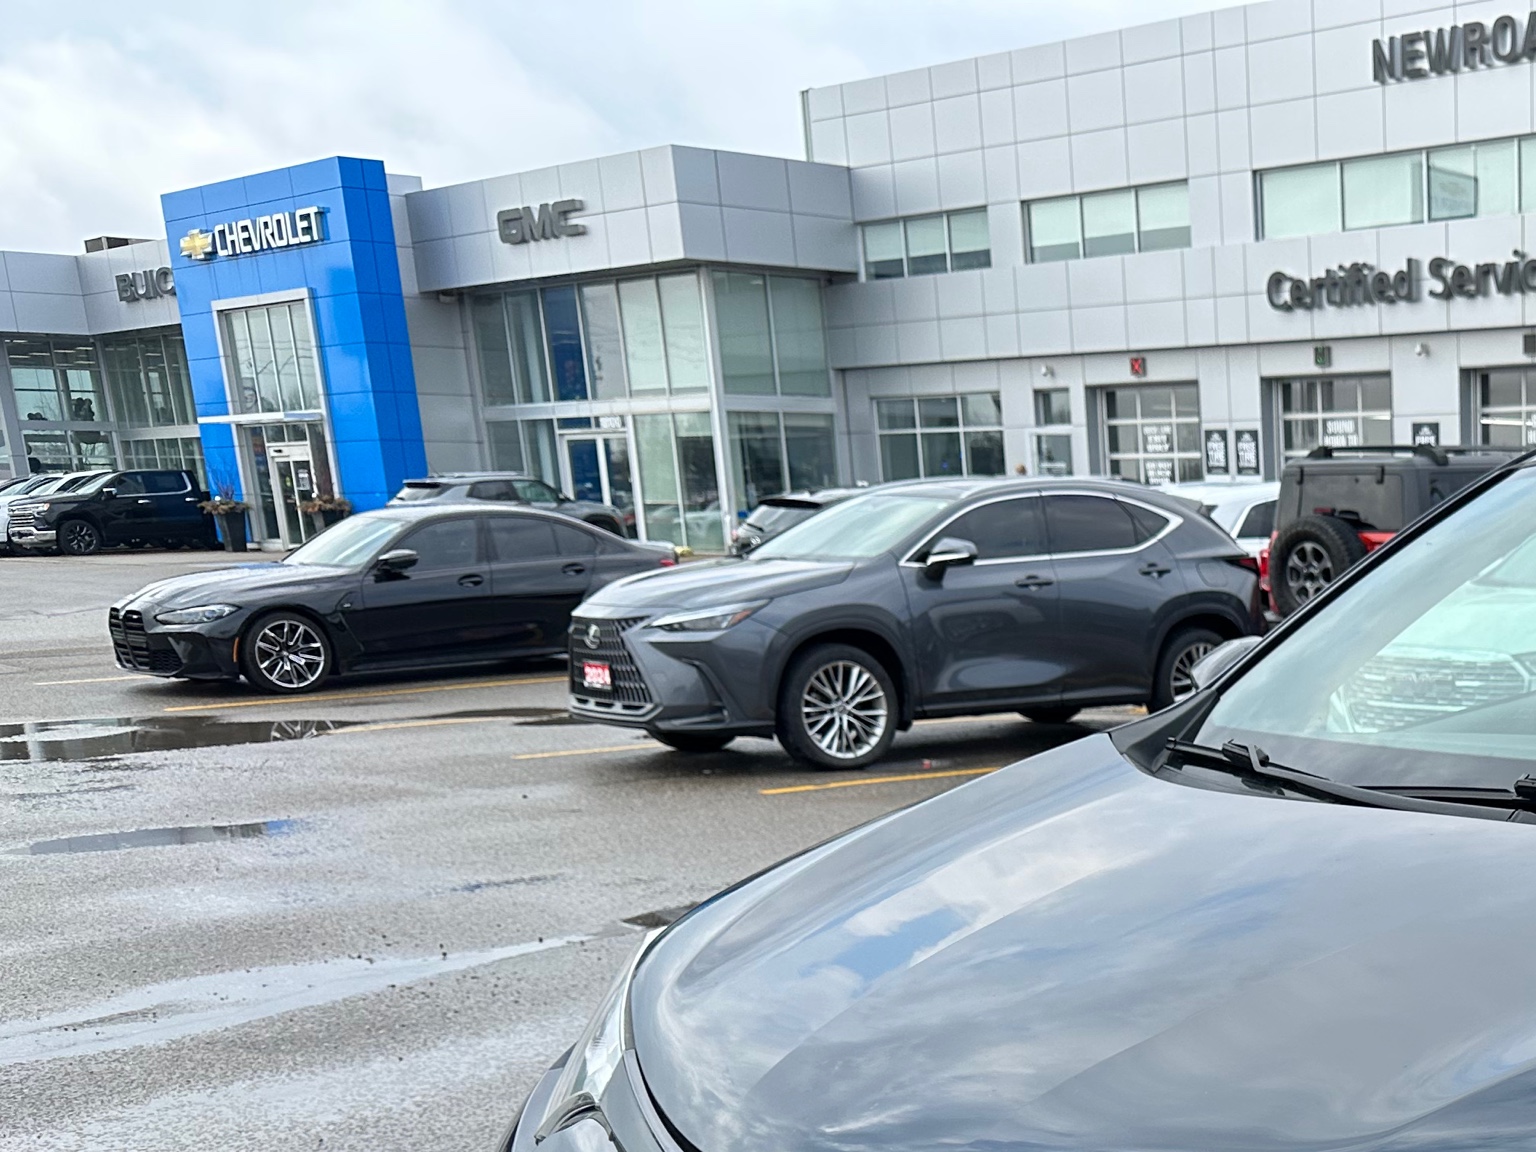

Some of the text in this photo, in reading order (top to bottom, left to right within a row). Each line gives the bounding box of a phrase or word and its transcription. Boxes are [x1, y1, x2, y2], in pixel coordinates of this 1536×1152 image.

[213, 206, 324, 257] CHEVROLET
[497, 199, 586, 244] GMC
[115, 266, 176, 301] BUIC
[1267, 257, 1421, 311] Certified
